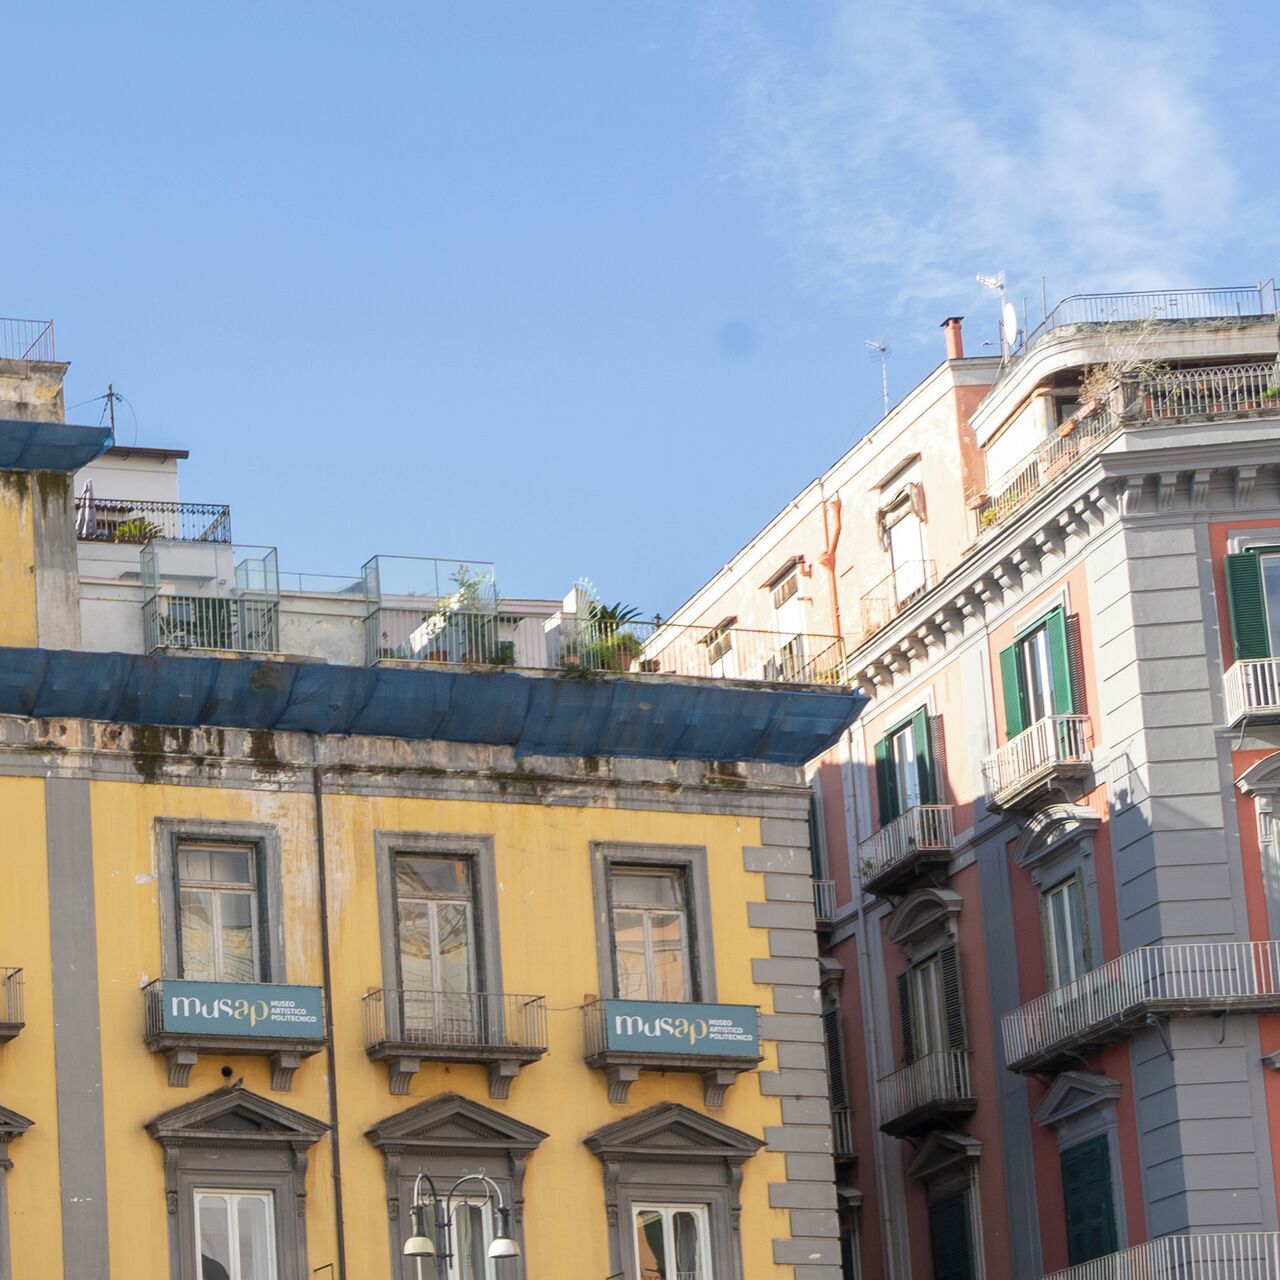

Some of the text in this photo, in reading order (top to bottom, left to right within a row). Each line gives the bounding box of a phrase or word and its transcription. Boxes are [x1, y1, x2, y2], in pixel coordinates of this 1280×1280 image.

[270, 1000, 296, 1008] MUSEO
[171, 996, 270, 1027] musap
[270, 1007, 307, 1015] ARTISTICO
[271, 1014, 317, 1023] POLITECNICO
[708, 1019, 733, 1027] MUSEO
[615, 1015, 708, 1046] musap
[709, 1026, 744, 1034] ARTISTICO
[709, 1033, 753, 1042] POLITECNICO
